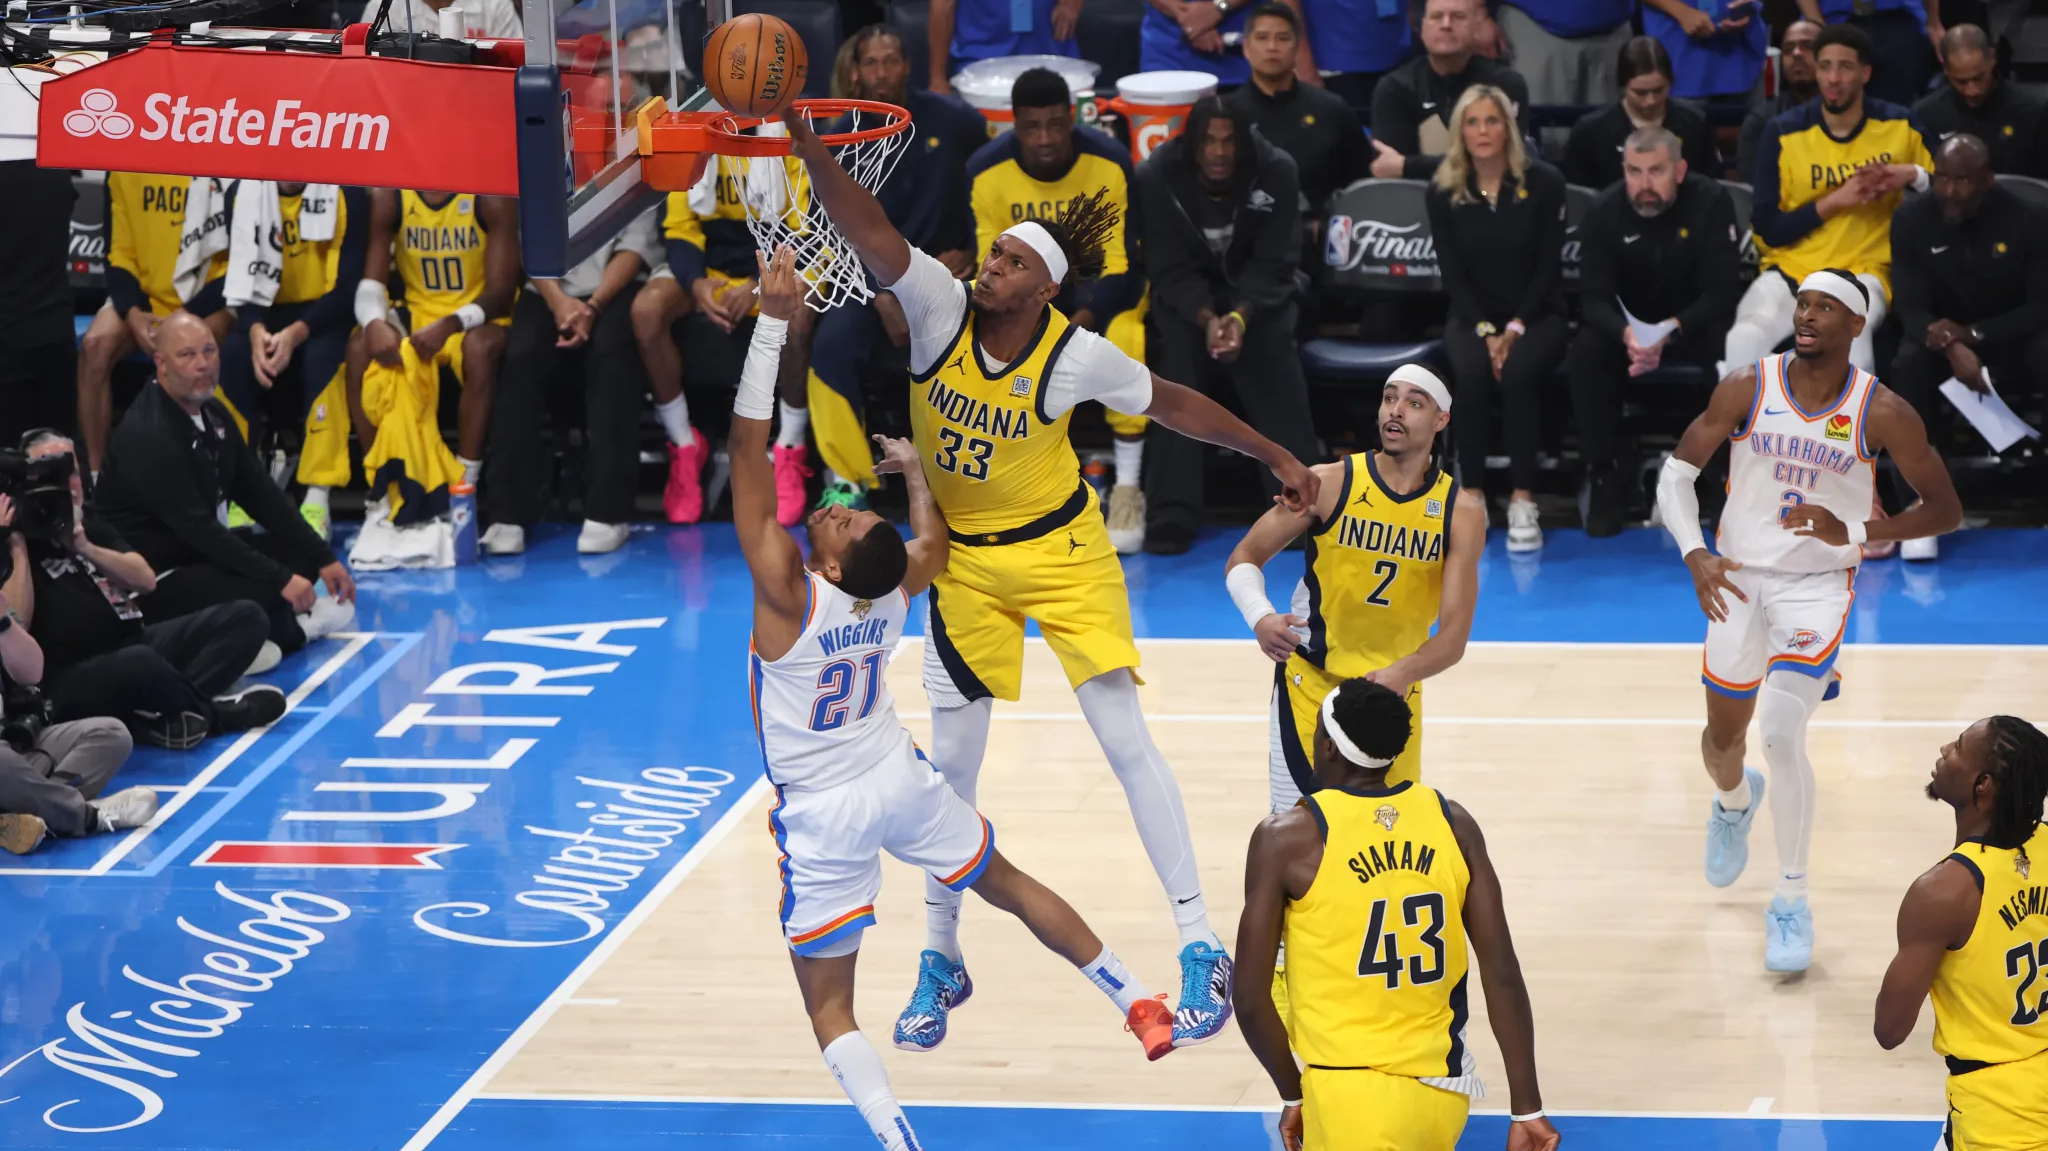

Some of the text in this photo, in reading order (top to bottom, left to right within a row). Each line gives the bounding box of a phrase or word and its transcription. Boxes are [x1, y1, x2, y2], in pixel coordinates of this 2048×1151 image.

[760, 33, 786, 99] Wilson
[404, 225, 480, 252] NDIANA
[420, 256, 466, 292] 00
[927, 377, 1028, 439] INDIANA
[935, 426, 994, 482] 33
[1750, 431, 1857, 476] OKLAHOMA
[1773, 460, 1822, 491] CITY
[1338, 514, 1442, 562] INDIANA
[1364, 558, 1401, 608] 2
[817, 618, 888, 657] WIGGINS
[808, 649, 884, 732] 21
[280, 617, 669, 822] ULTRA
[413, 766, 736, 948] Courtside
[1347, 840, 1436, 884] SIAKAM
[1998, 885, 2048, 931] NESMI
[1356, 891, 1446, 991] 43
[43, 879, 351, 1134] Michelob
